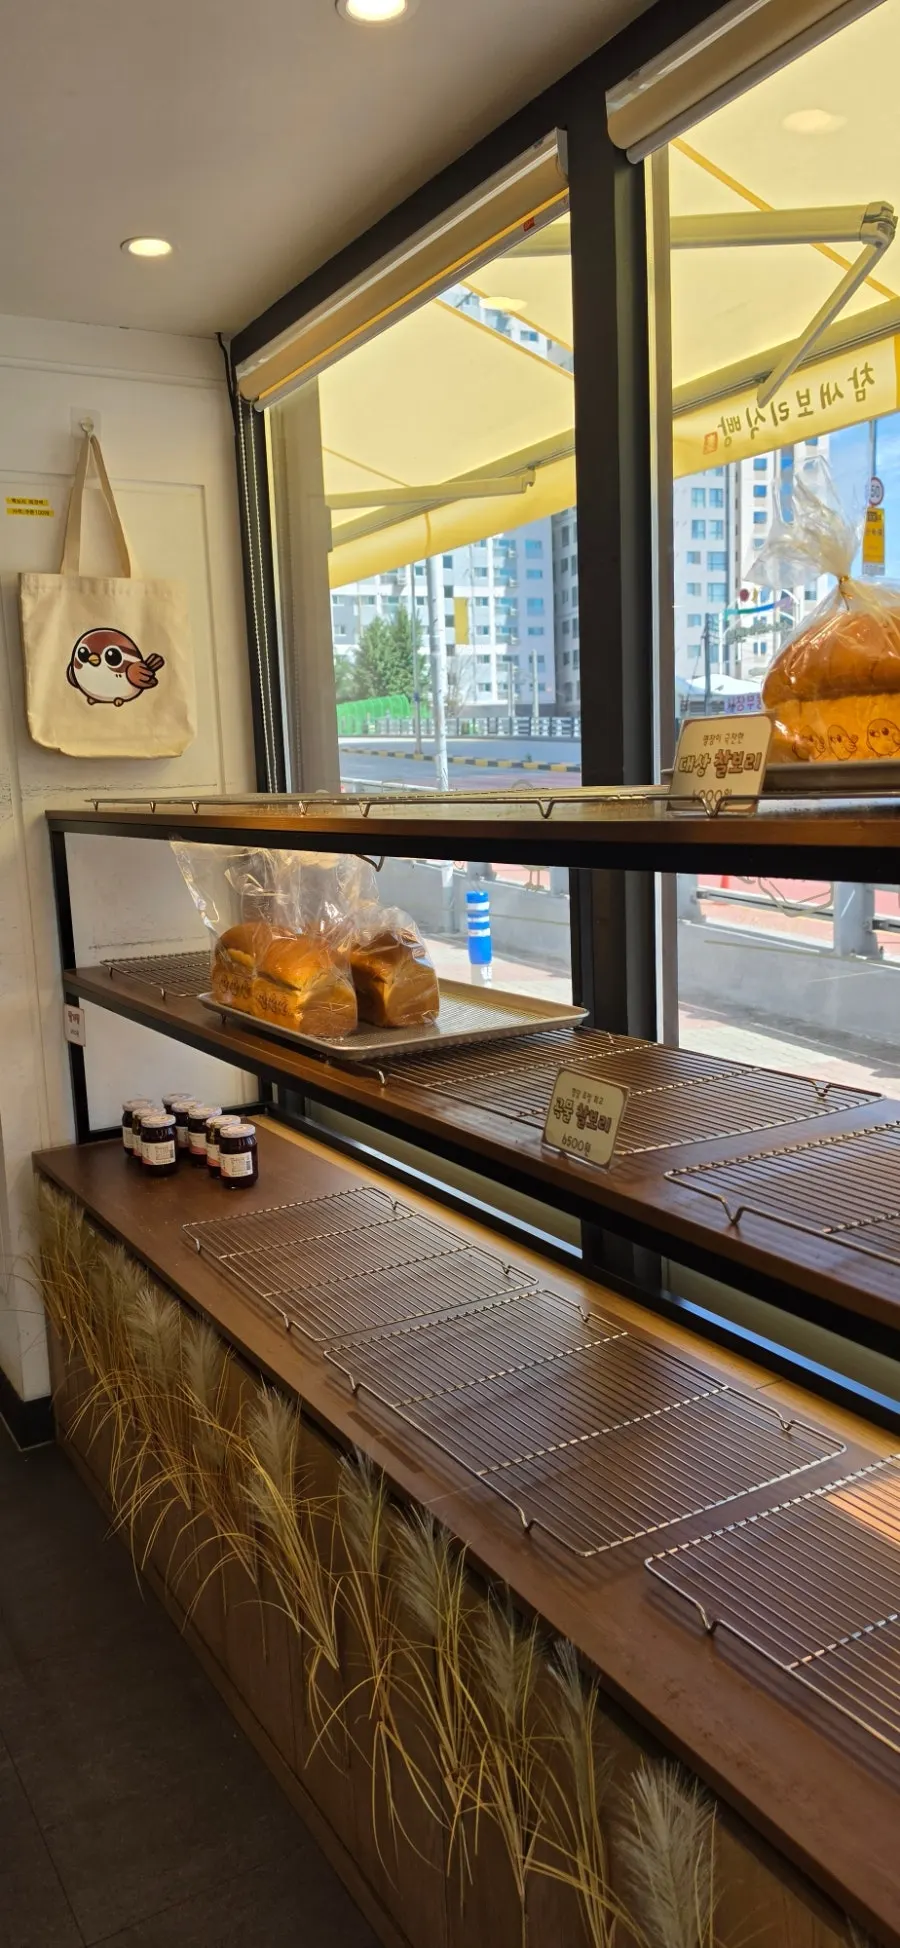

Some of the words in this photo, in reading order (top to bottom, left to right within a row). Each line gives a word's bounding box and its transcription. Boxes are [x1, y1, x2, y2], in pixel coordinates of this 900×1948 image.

[678, 752, 711, 777] 대상
[714, 748, 762, 779] 찰보리
[576, 1102, 612, 1134] 찰보리
[561, 1133, 592, 1157] 6500원
